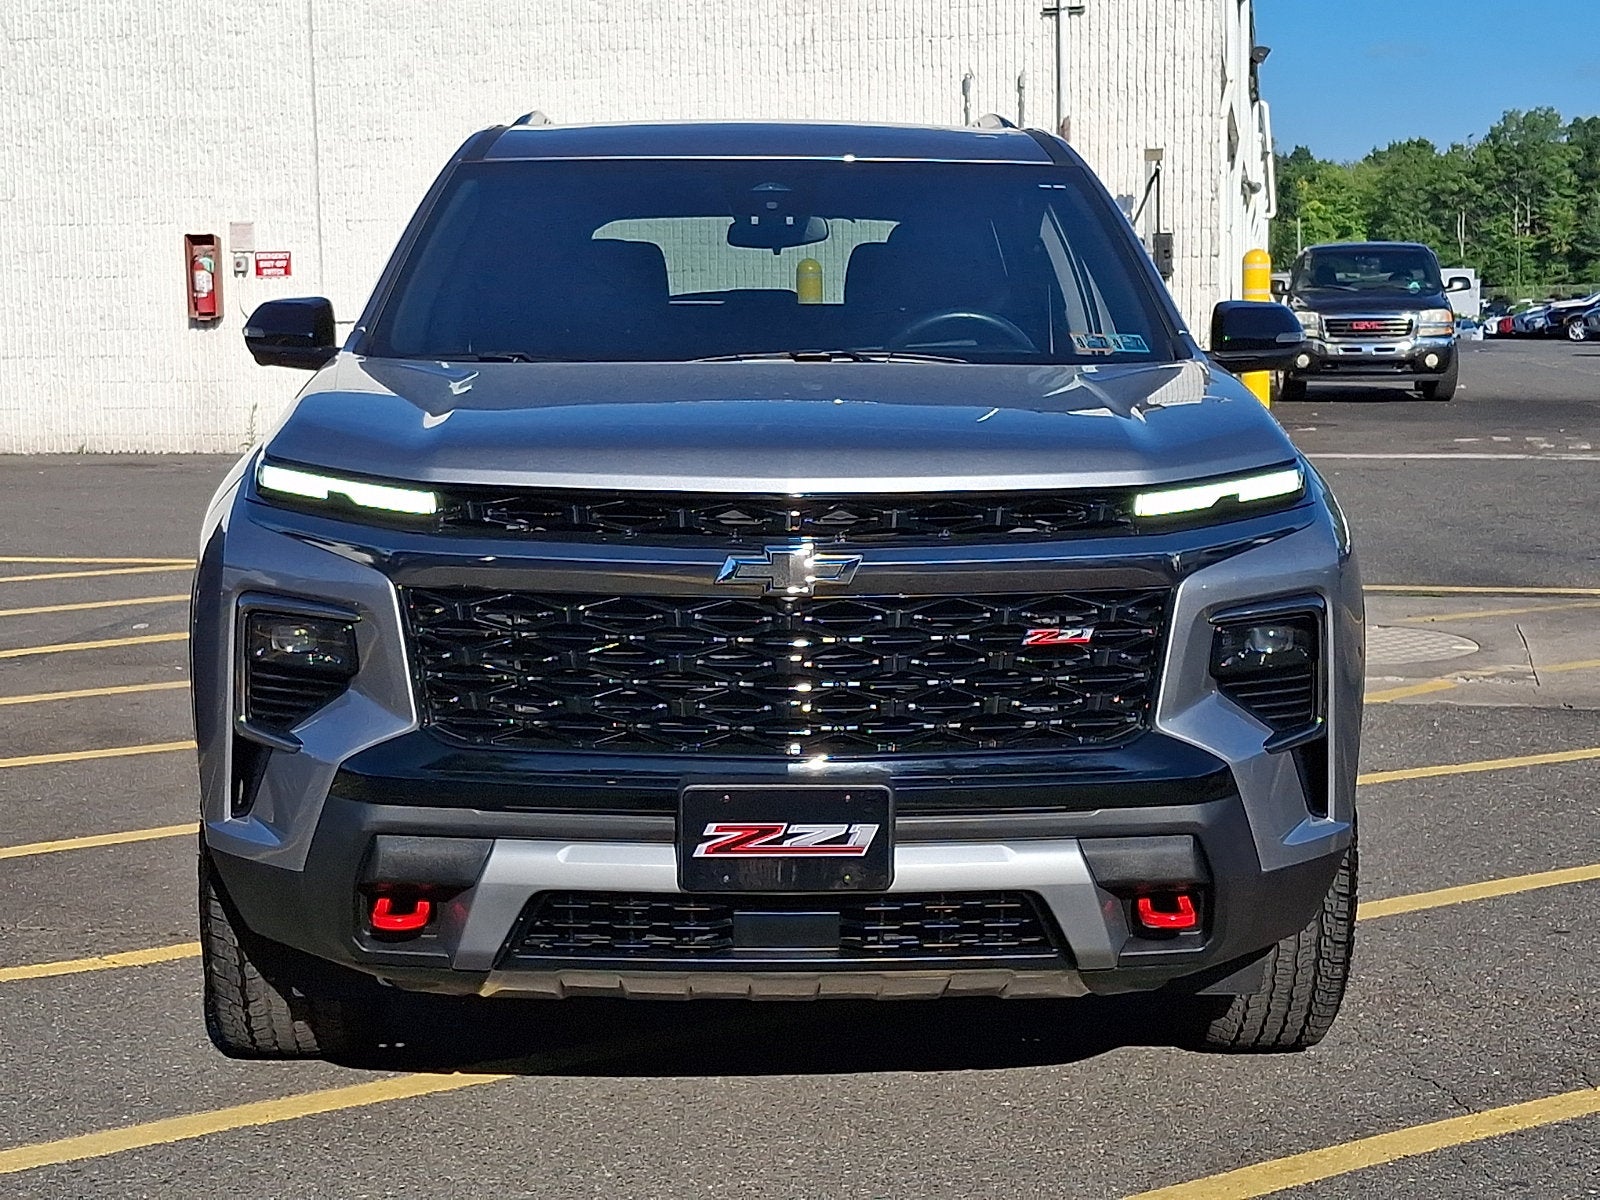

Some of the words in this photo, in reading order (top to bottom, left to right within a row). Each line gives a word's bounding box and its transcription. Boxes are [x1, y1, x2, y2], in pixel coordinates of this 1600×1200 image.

[1351, 320, 1383, 330] GMC
[1021, 627, 1095, 645] Z71
[693, 823, 880, 857] Z71
